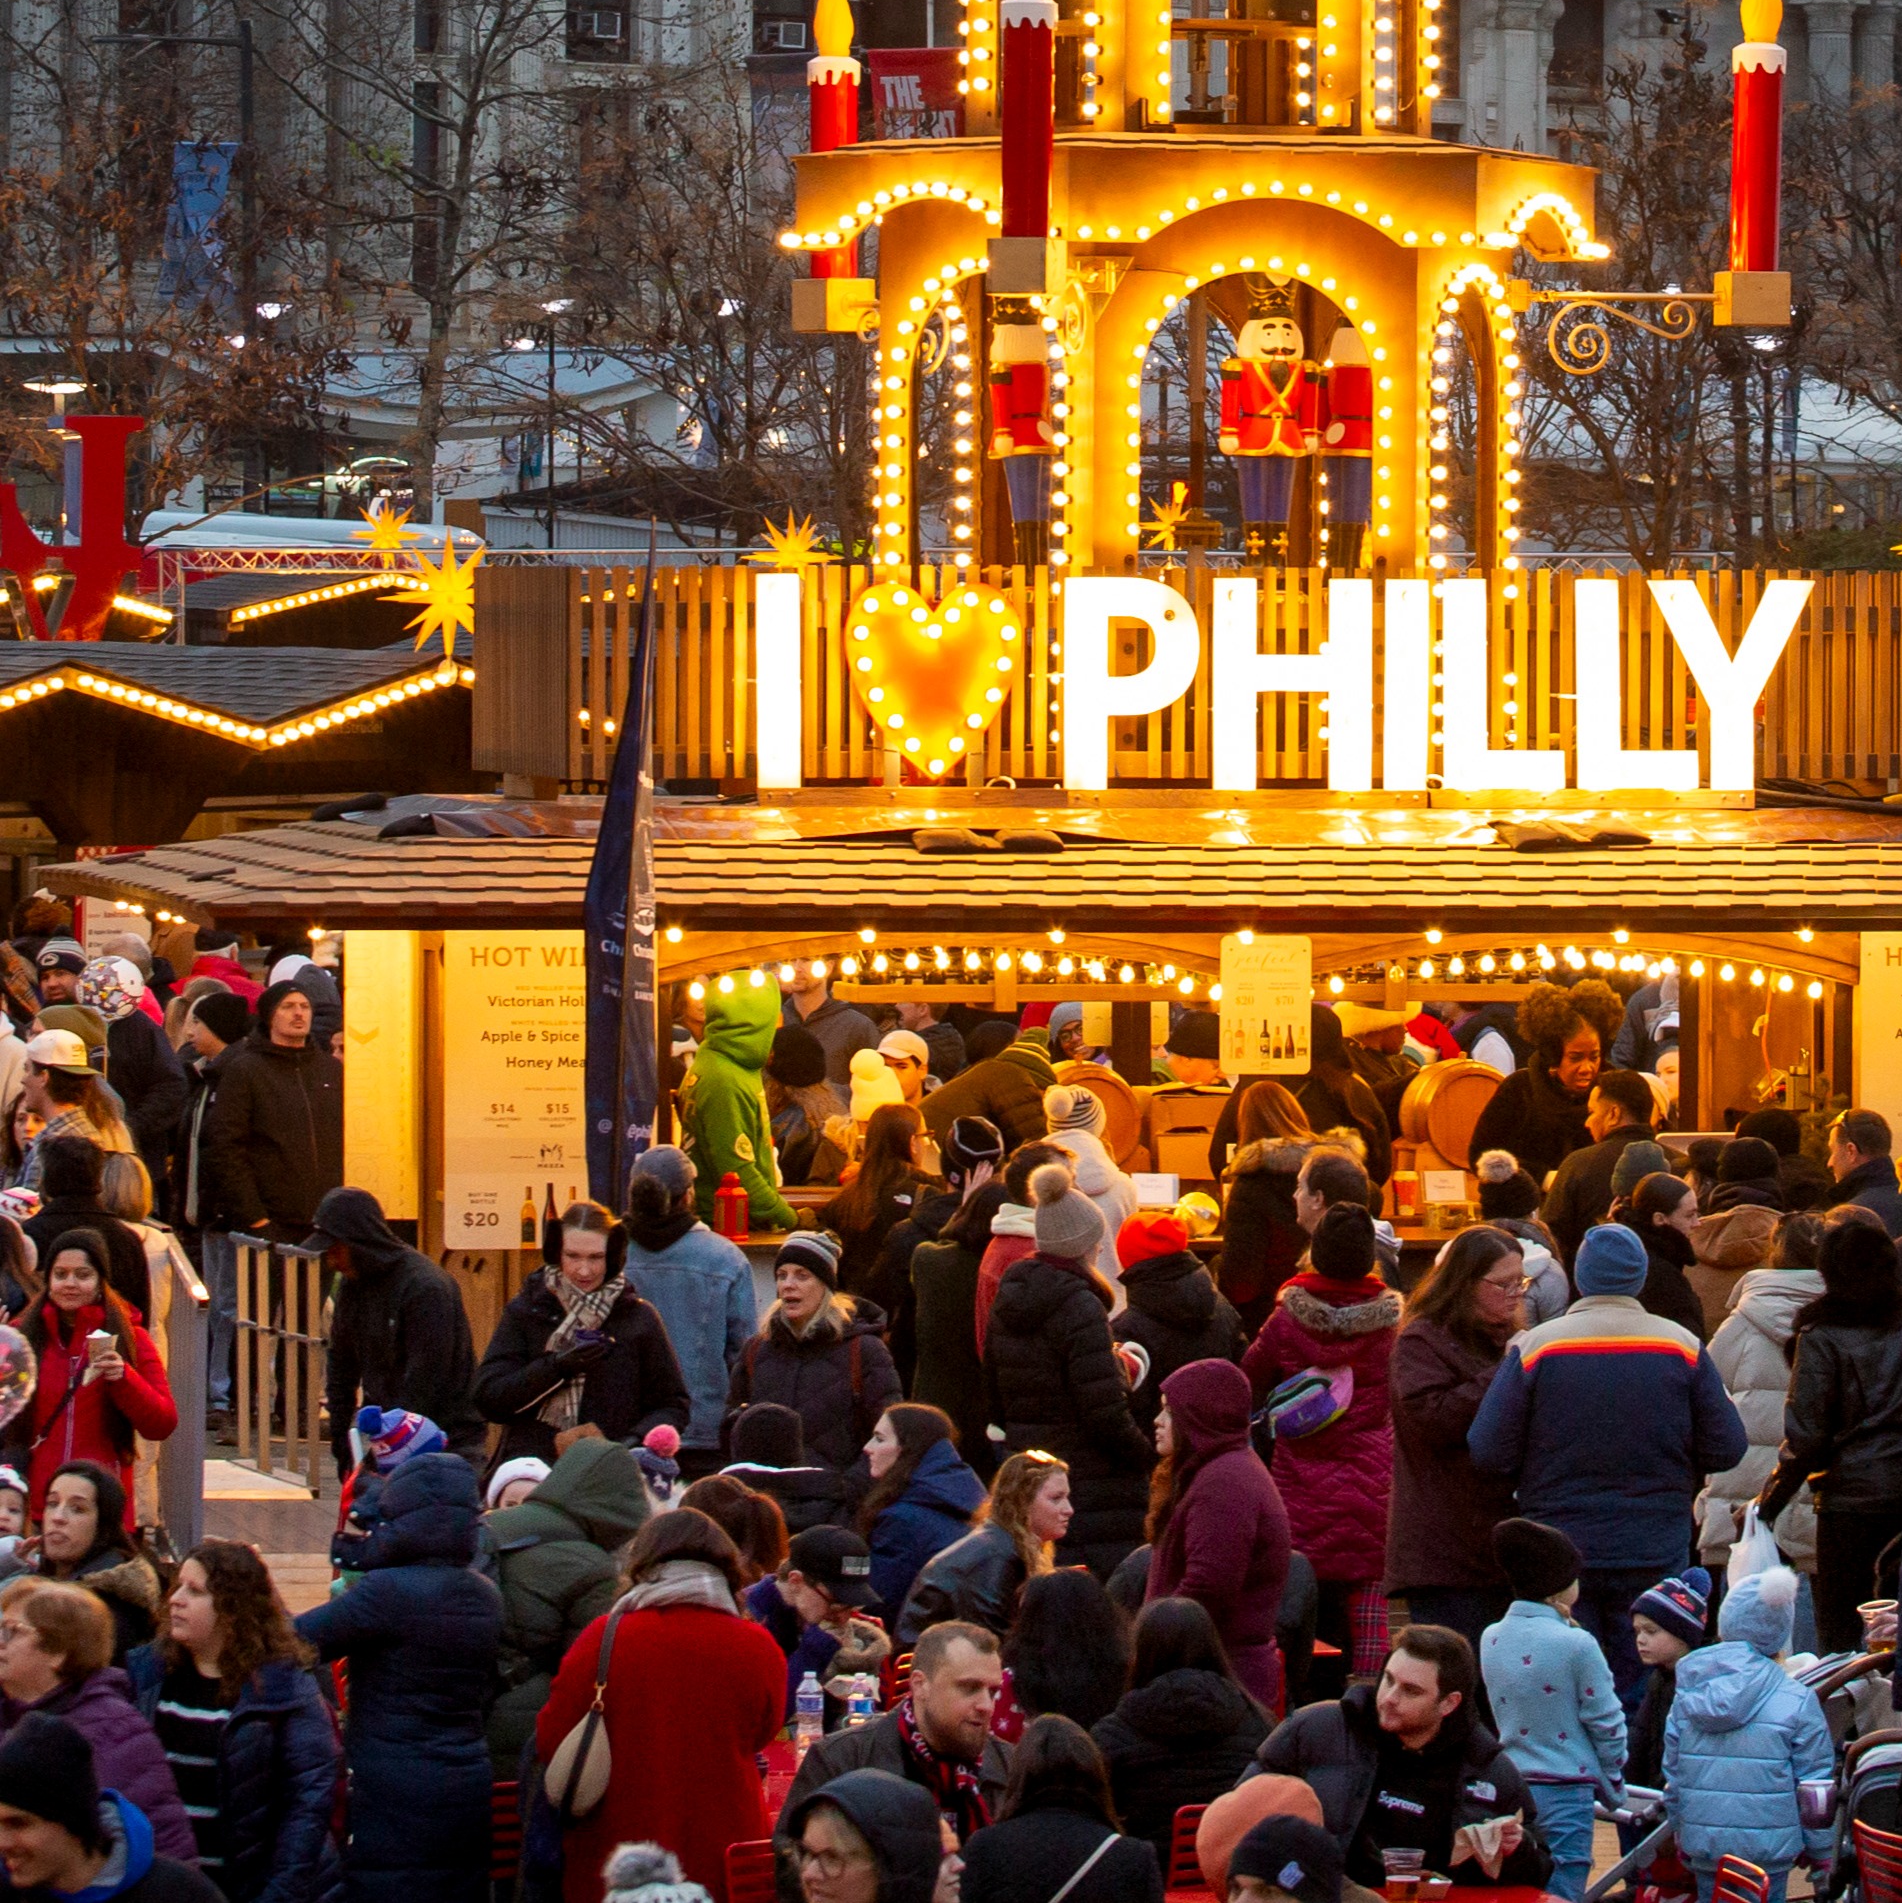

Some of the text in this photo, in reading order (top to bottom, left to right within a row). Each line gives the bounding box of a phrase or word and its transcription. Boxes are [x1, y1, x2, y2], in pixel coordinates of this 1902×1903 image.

[880, 75, 926, 111] THE
[1063, 576, 1816, 791] PHILLY
[471, 947, 585, 967] HOT WI
[488, 996, 554, 1007] Victorian
[481, 1030, 580, 1044] Apple & Spice
[506, 1057, 553, 1070] Honey
[491, 1104, 515, 1114] $14
[546, 1104, 569, 1114] $15
[463, 1212, 499, 1227] $20
[1378, 1790, 1425, 1814] Supreme
